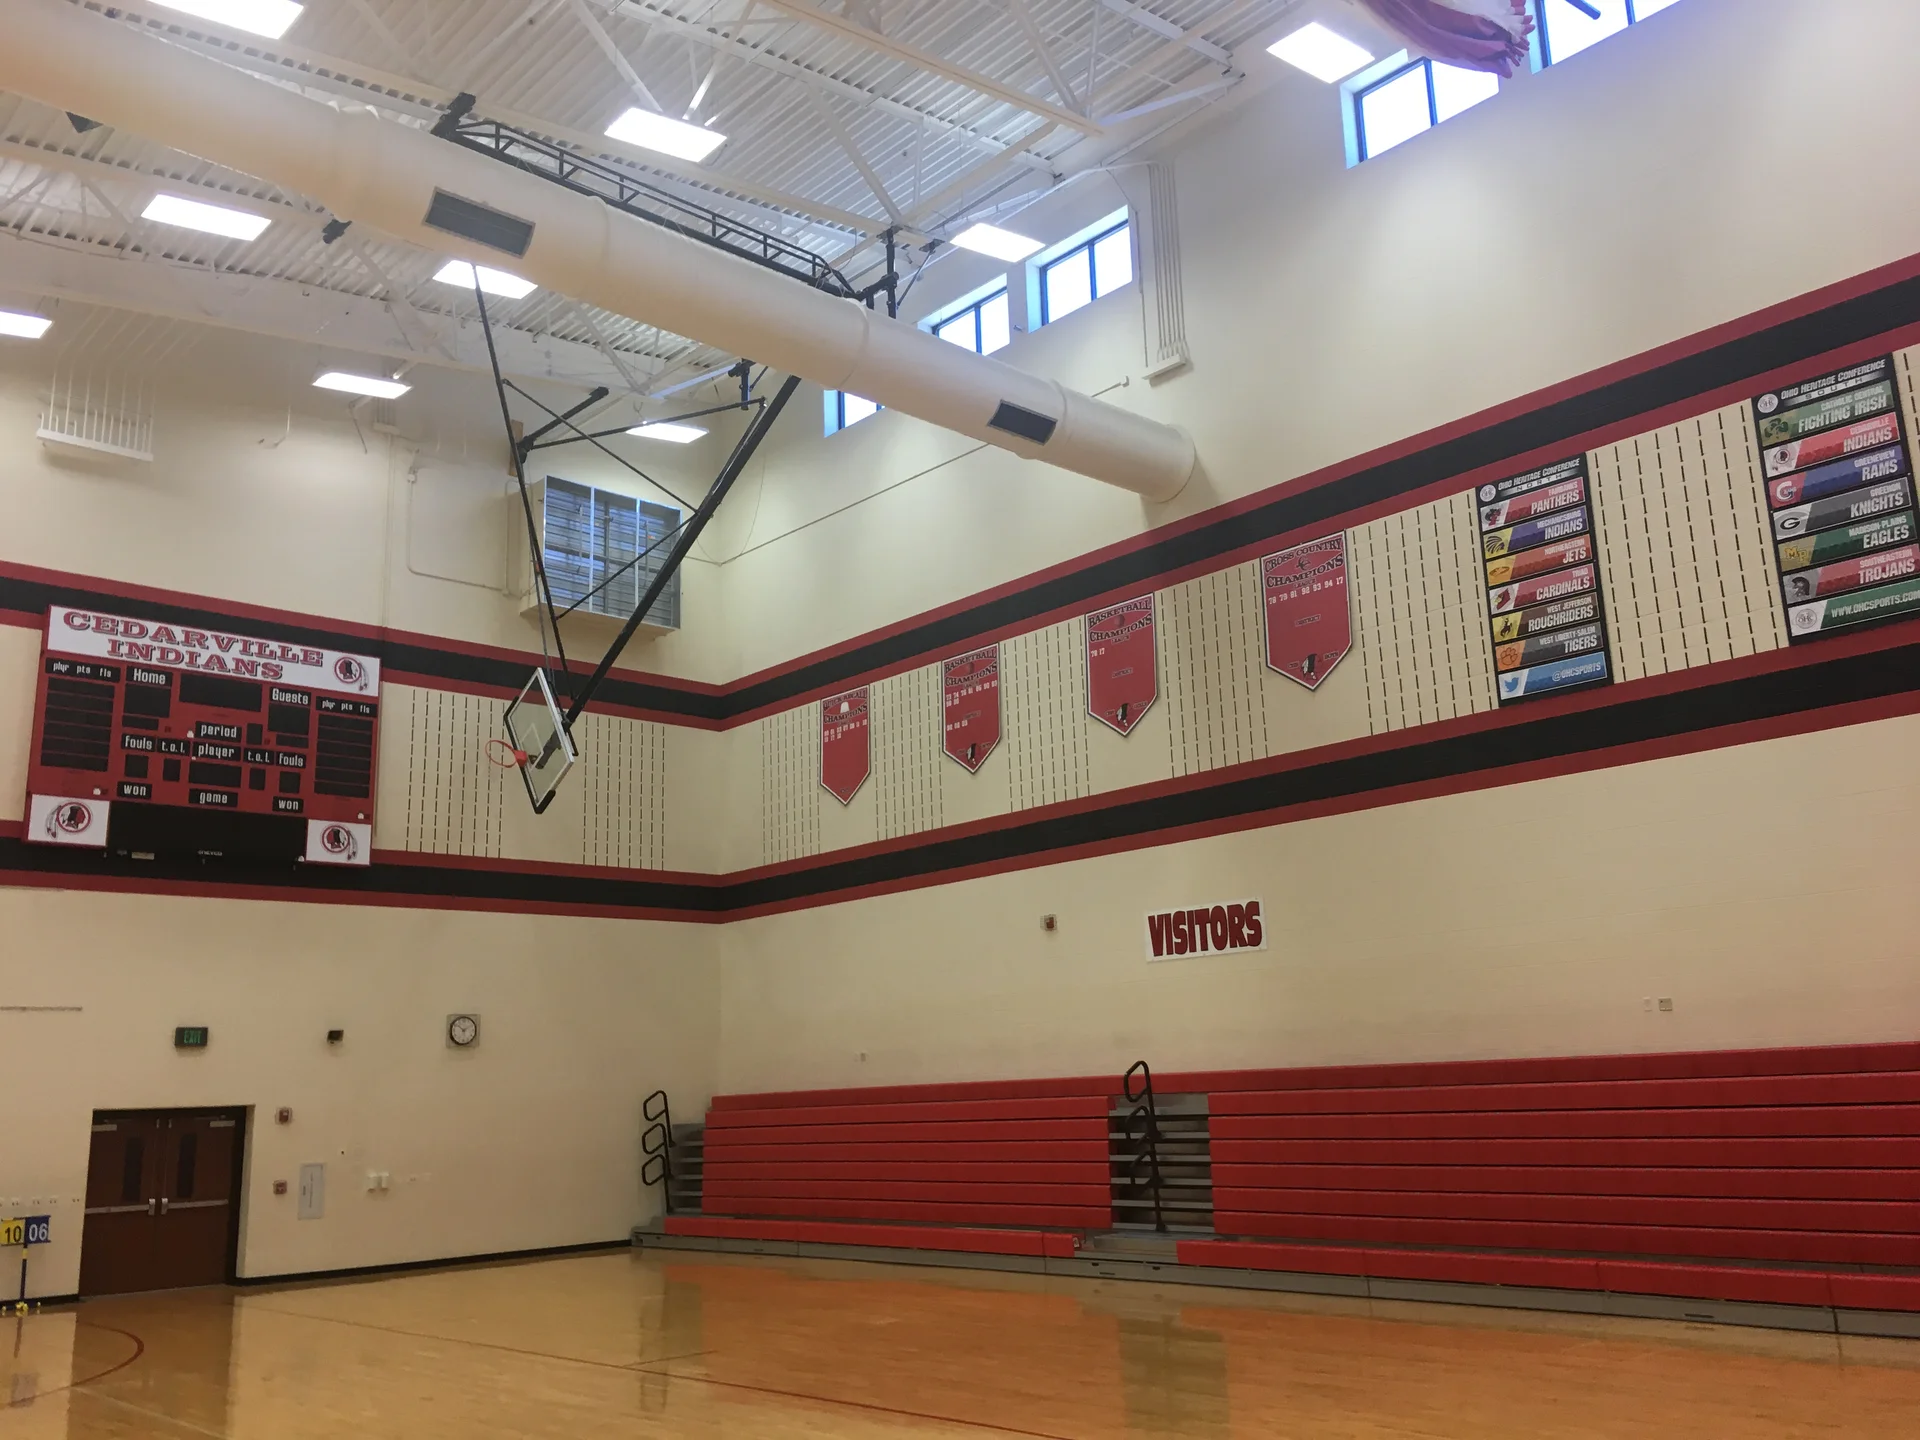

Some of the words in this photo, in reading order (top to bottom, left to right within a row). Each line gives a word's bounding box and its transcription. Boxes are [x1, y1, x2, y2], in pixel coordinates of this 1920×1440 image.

[1781, 388, 1799, 400] OHIO
[1800, 377, 1836, 395] HERITAGE
[1837, 359, 1886, 382] CONFERENCE
[1805, 377, 1863, 400] SOUTH
[1854, 386, 1885, 401] CENTRAL
[1798, 406, 1850, 433] FIGHTING
[1854, 394, 1887, 416] IRISH
[1843, 426, 1893, 453] INDIANS
[1498, 480, 1513, 491] OHIO
[1513, 470, 1541, 486] HERITAGE
[1542, 458, 1581, 477] CONFERENCE
[1861, 459, 1898, 481] RAMS
[1516, 473, 1563, 491] NORTH
[1530, 490, 1580, 515] PANTHERS
[1850, 492, 1904, 518] KNIGHTS
[1544, 518, 1583, 540] INDIANS
[1849, 515, 1907, 537] MADISON-PLAINS
[1863, 524, 1910, 549] EAGLES
[1264, 553, 1295, 573] CROSS
[1296, 538, 1343, 556] COUNTRY
[1562, 547, 1587, 564] JETS
[1266, 553, 1344, 588] CHAMPIONS
[1336, 576, 1344, 585] 17
[1858, 558, 1916, 584] TROJANS
[1536, 576, 1590, 601] CARDINALS
[1088, 600, 1152, 628] BASKETBALL
[1547, 602, 1561, 614] WEST
[1563, 596, 1592, 610] JEFFERSON
[1830, 589, 1920, 618] WWW.OHCSPORTS.COM
[1089, 613, 1152, 643] CHAMPIONS
[1528, 604, 1594, 632] ROUGHRIDERS
[62, 610, 324, 667] CEDARVILLE
[1539, 634, 1554, 646] WEST
[1555, 626, 1596, 643] LIBERTY-SALEM
[1563, 634, 1598, 654] TIGERS
[52, 661, 70, 674] plyr
[76, 663, 91, 676] pts
[99, 667, 112, 678] fls
[106, 638, 285, 680] INDIANS
[944, 649, 997, 674] BASKETBALL
[133, 668, 166, 686] Home
[945, 661, 998, 687] CHAMPIONS
[1551, 662, 1601, 682] @OHCSPORTS
[271, 688, 309, 706] Guests
[322, 699, 336, 711] plyr
[340, 700, 354, 712] pts
[359, 703, 371, 714] fls
[823, 701, 868, 723] CHAMPIONS
[200, 723, 237, 740] period
[125, 736, 153, 751] fouls
[198, 743, 235, 760] player
[279, 752, 304, 768] fouls
[123, 783, 147, 798] won
[200, 790, 228, 806] game
[278, 799, 299, 812] won
[1147, 901, 1263, 957] VISITORS
[183, 1030, 202, 1045] EXIT
[4, 1225, 22, 1243] 10
[28, 1223, 48, 1242] 06
